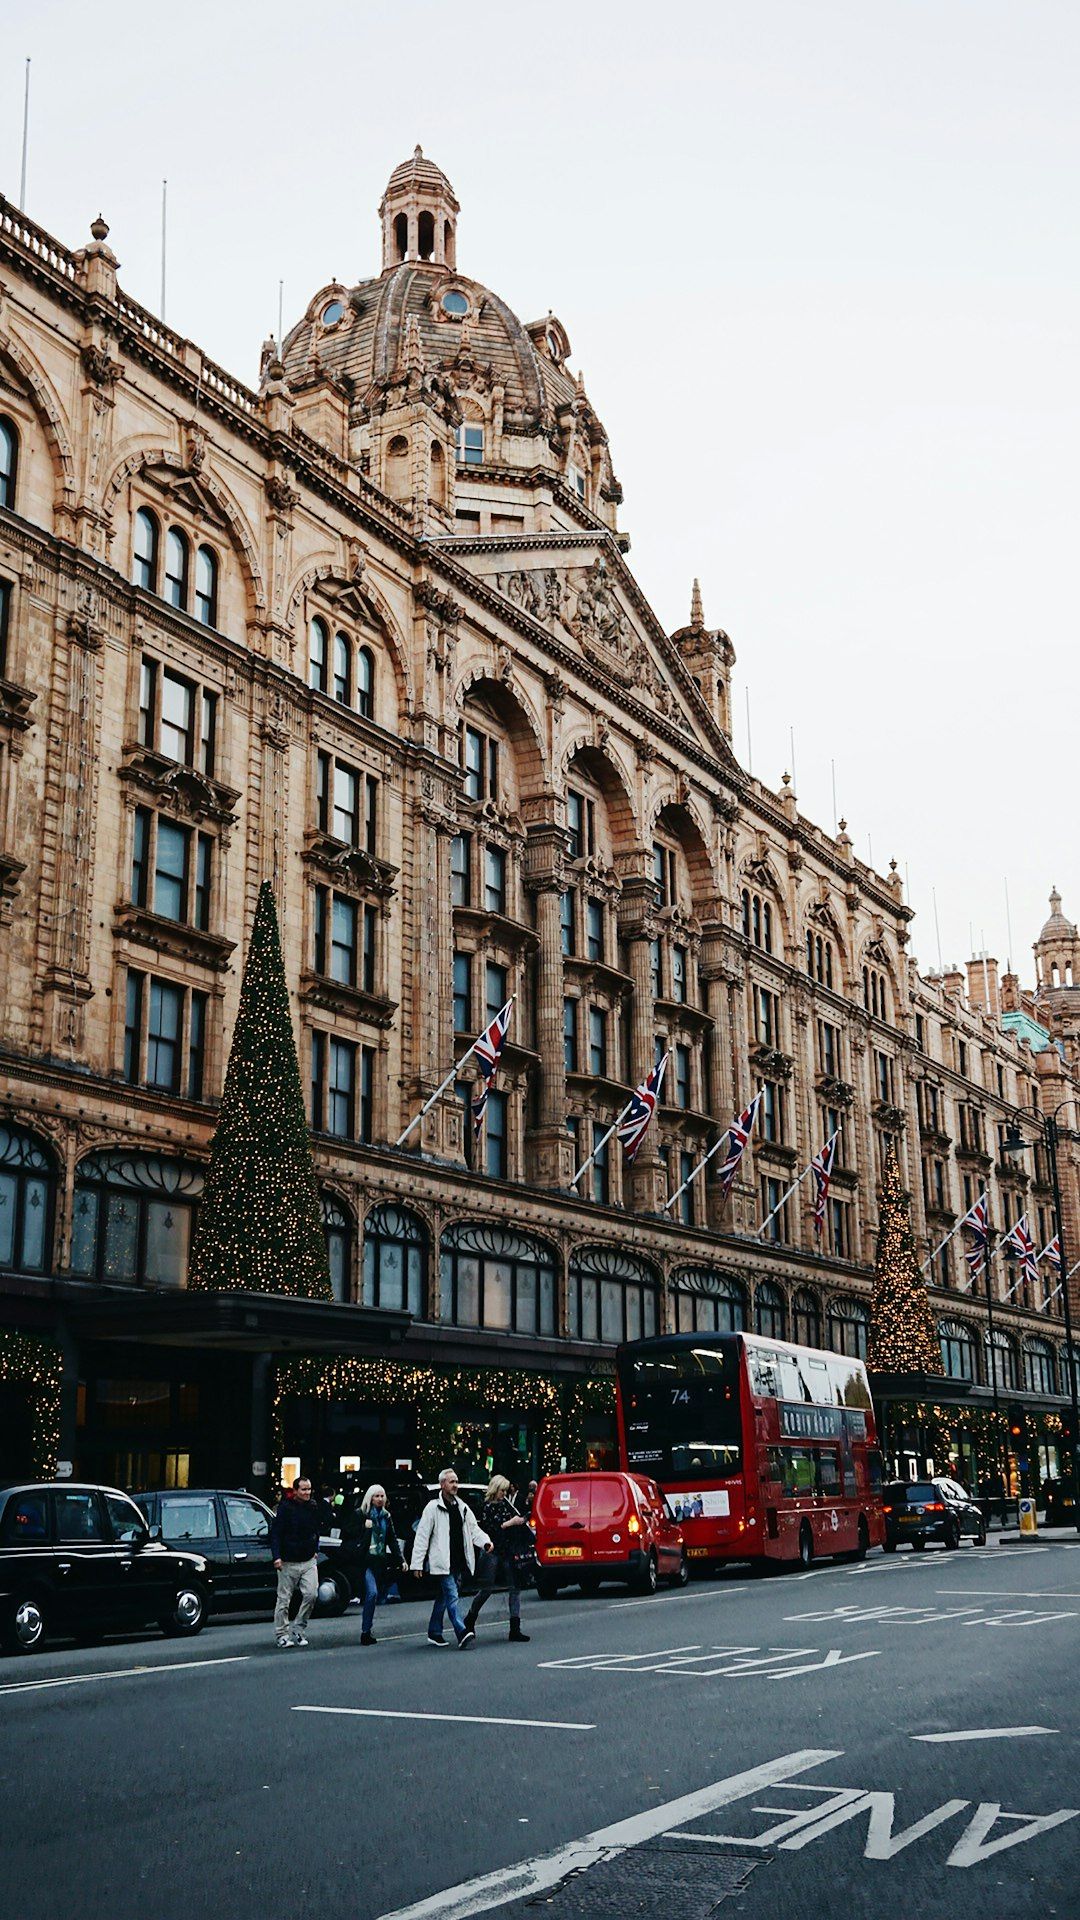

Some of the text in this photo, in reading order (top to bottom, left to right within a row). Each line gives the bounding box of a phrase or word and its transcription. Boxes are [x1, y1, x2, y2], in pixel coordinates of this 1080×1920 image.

[671, 1389, 690, 1405] 74
[782, 1605, 1078, 1626] CLEAR
[537, 1645, 882, 1679] KEEP
